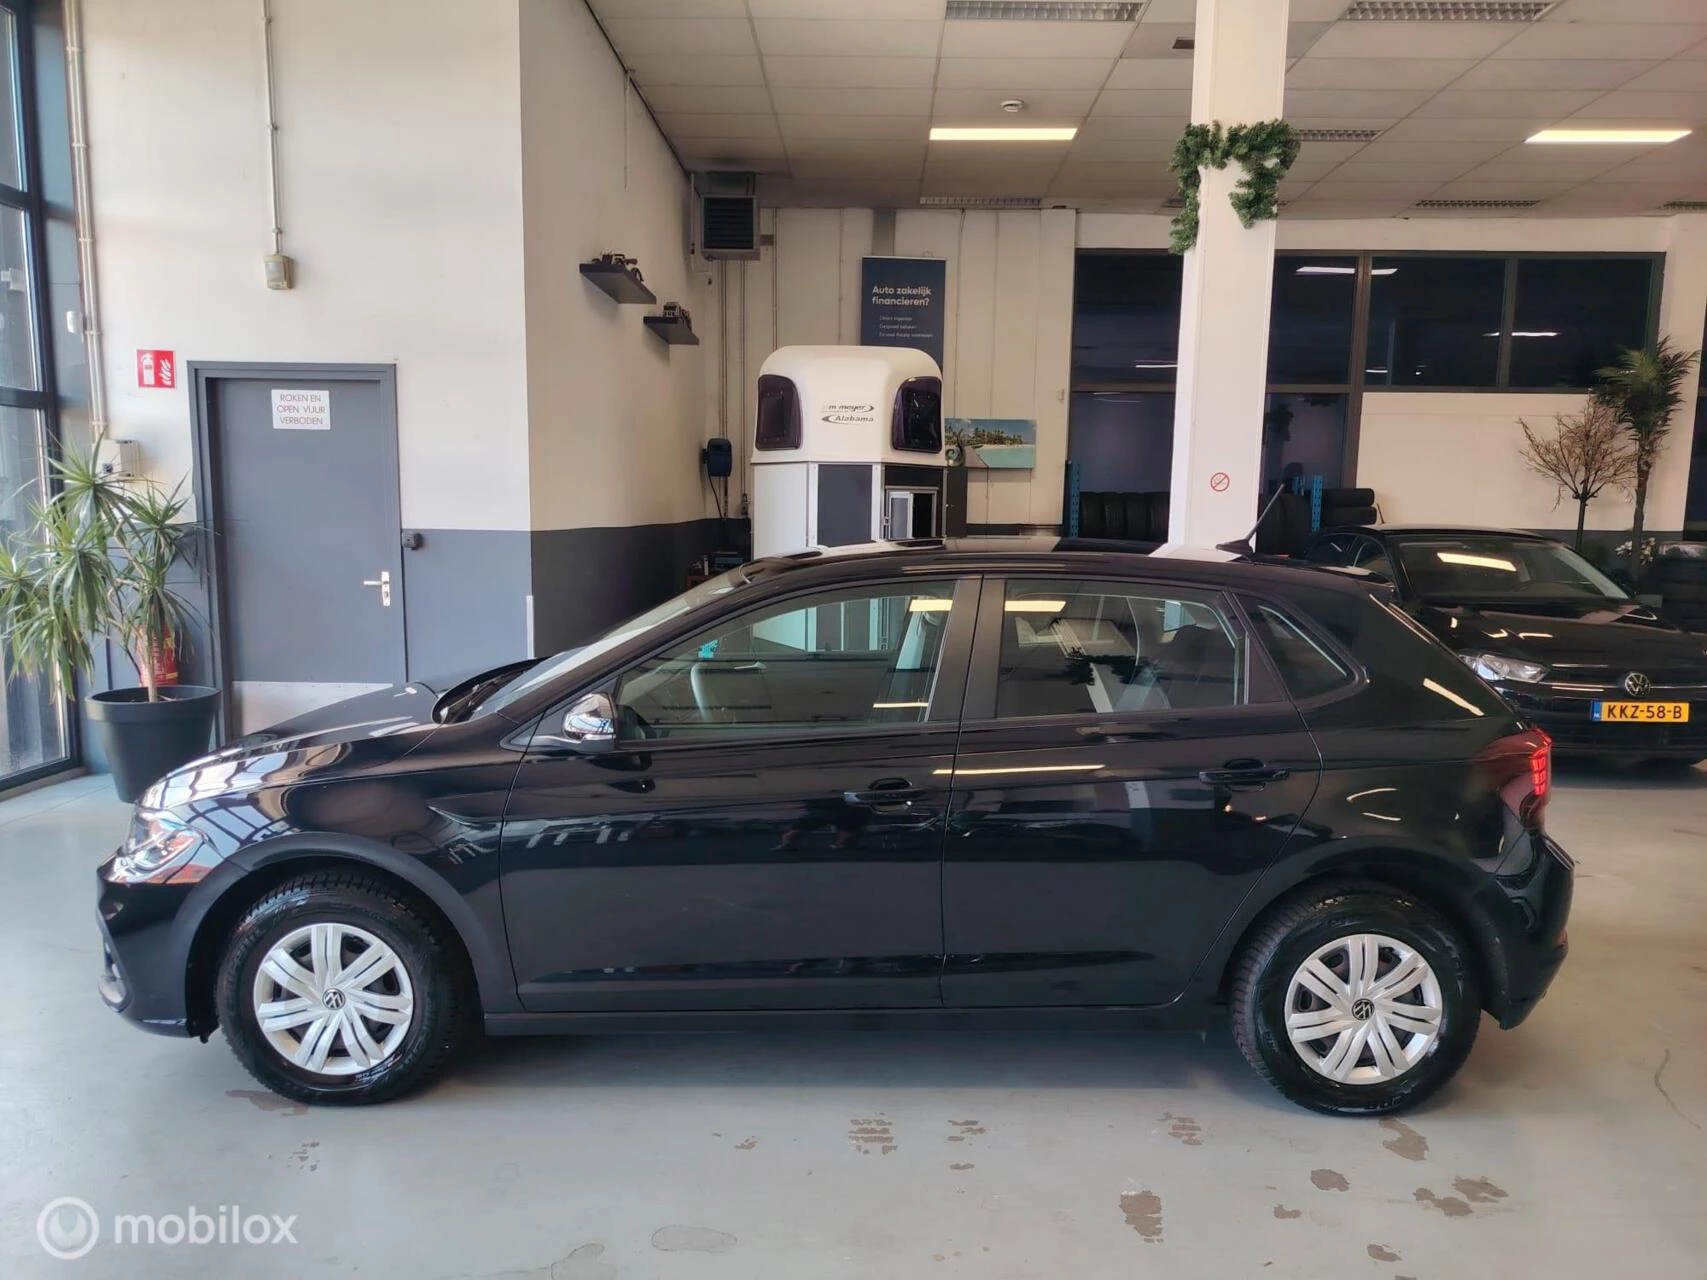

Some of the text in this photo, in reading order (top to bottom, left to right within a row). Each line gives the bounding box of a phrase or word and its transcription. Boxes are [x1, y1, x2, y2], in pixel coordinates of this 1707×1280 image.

[872, 286, 932, 297] Auto zakelijk
[872, 296, 930, 306] financieren?
[280, 393, 321, 403] ROKEN EN
[277, 405, 300, 413] OPEN
[279, 416, 323, 425] VERBODEN
[1607, 704, 1682, 719] KKZ-58-B
